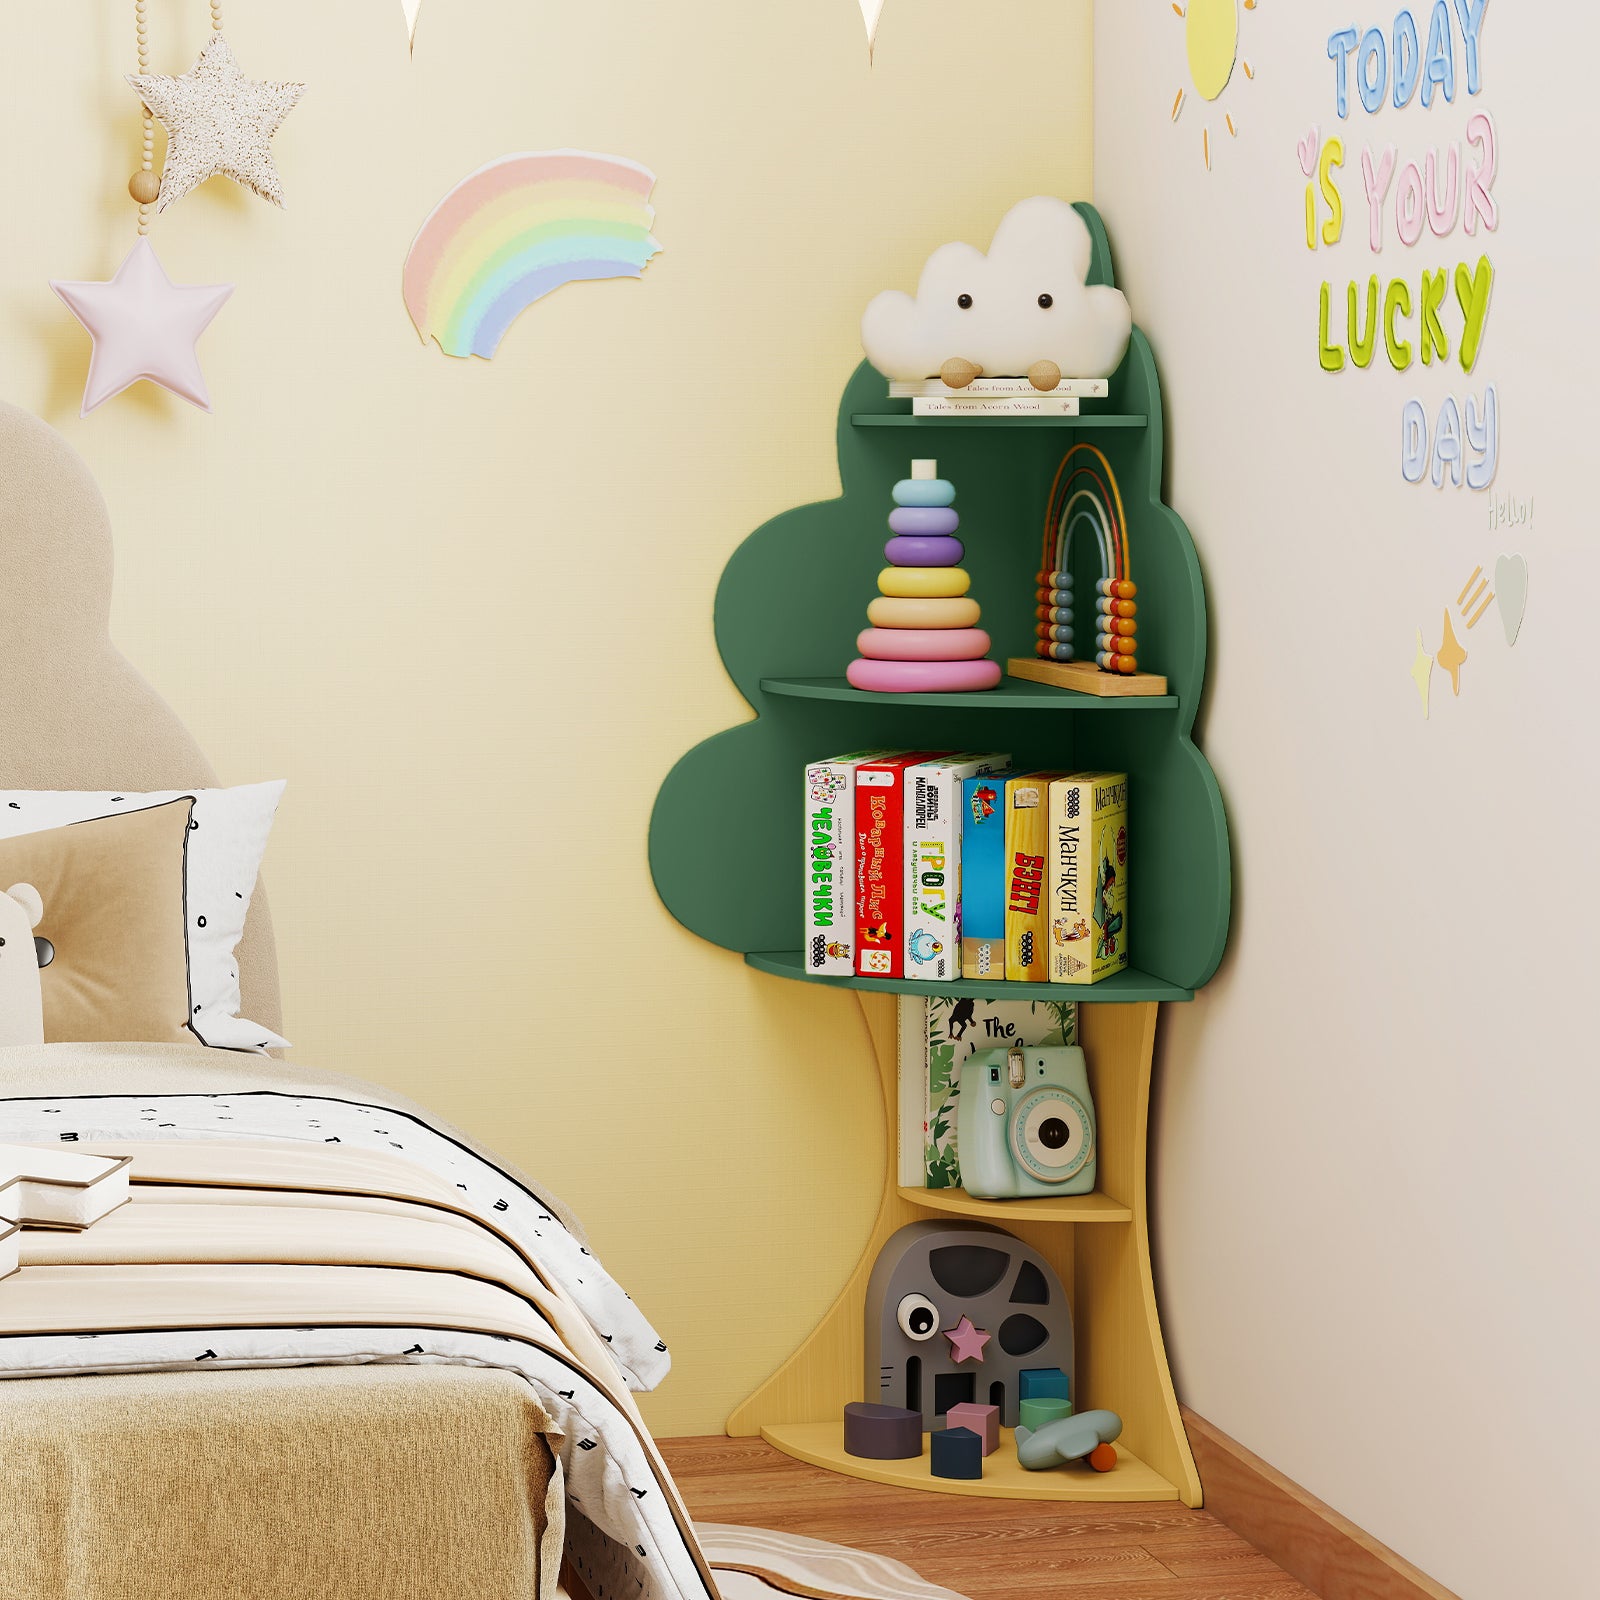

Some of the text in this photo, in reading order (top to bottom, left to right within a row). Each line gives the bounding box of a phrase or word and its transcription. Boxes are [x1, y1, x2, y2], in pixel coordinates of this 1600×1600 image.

[1326, 0, 1489, 119] TODAY
[1361, 110, 1500, 253] YOUR
[1318, 254, 1496, 374] LUCKY
[954, 402, 978, 411] from
[980, 402, 1010, 411] Acorn
[1012, 402, 1041, 411] Wood
[991, 384, 1014, 392] from
[1400, 382, 1500, 490] DAY
[915, 777, 927, 830] МАНДАЛОРЕЦ
[927, 785, 935, 821] ВОЙНЫ
[920, 841, 946, 922] ГРОГУ
[1009, 852, 1045, 916] БЭНГ!
[1056, 825, 1080, 913] Манчкин
[869, 884, 886, 920] Лис
[983, 1016, 1016, 1038] The
